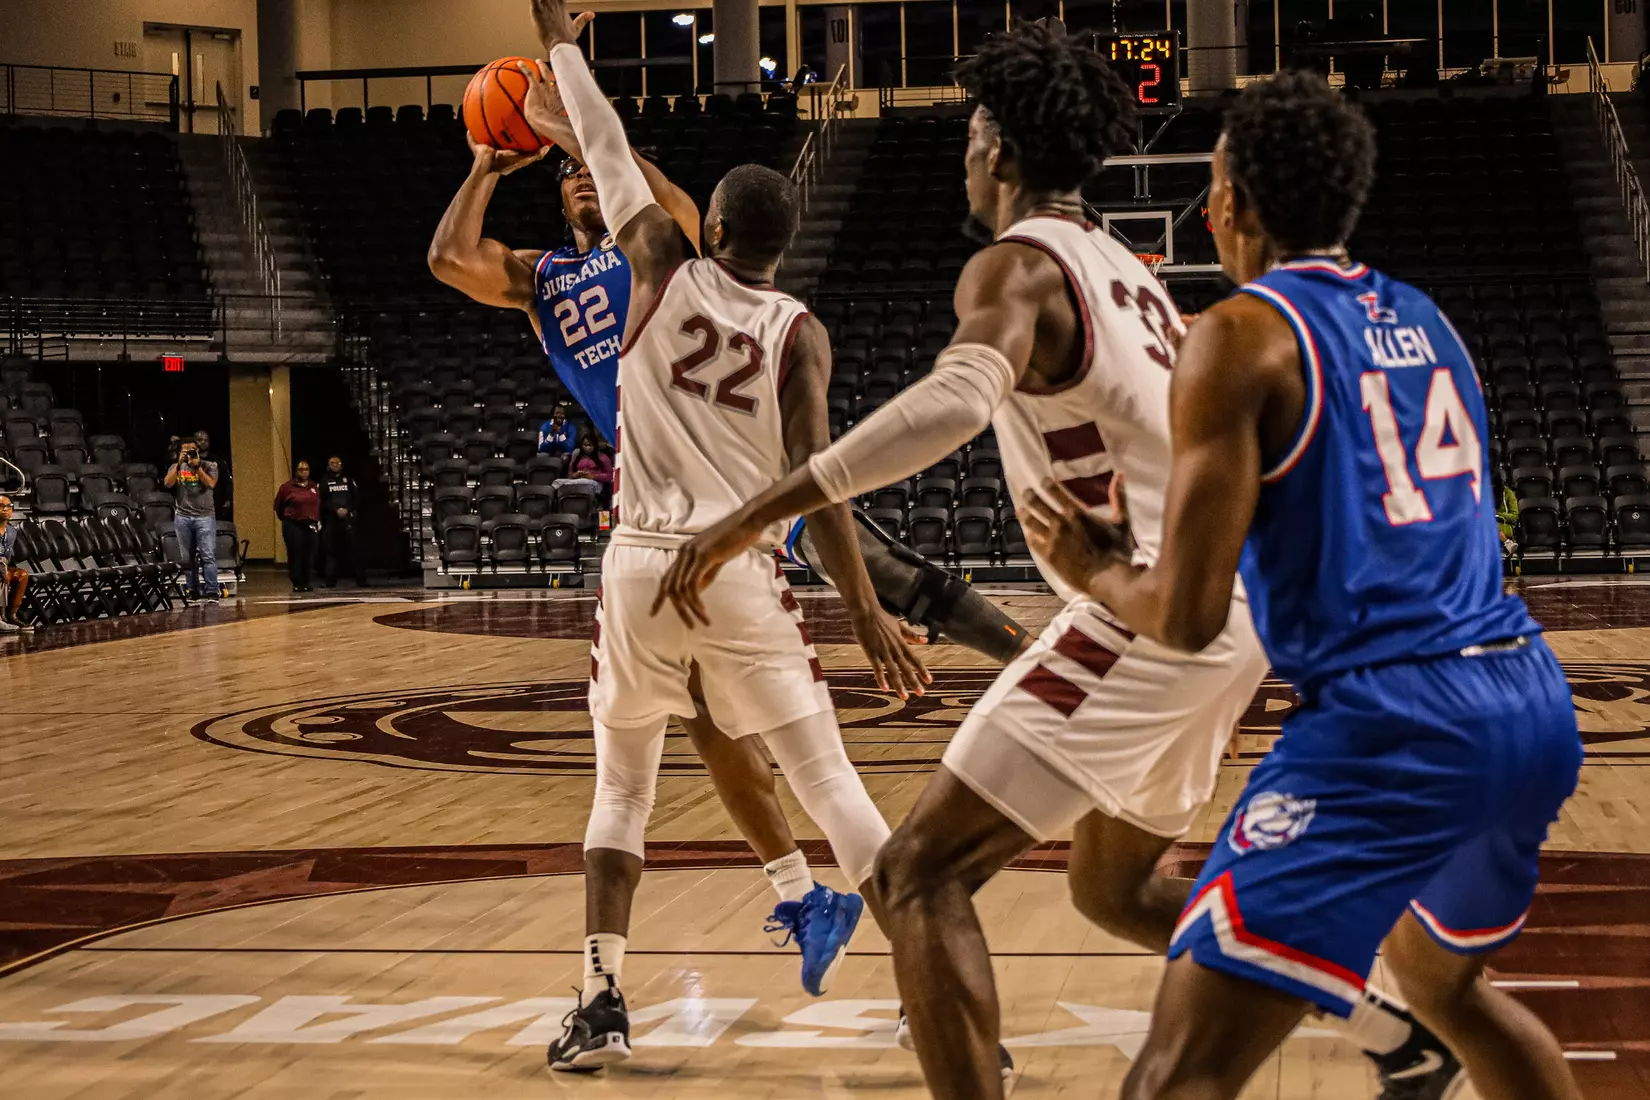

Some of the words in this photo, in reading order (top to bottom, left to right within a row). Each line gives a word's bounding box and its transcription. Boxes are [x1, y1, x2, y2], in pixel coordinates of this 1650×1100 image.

[1111, 38, 1170, 61] 17:24
[1138, 64, 1160, 103] 2
[553, 284, 617, 348] 22
[574, 334, 622, 370] TECH
[669, 312, 767, 419] 22
[1363, 325, 1438, 368] ALLEN
[1359, 367, 1482, 527] 14
[329, 484, 348, 492] POLICE
